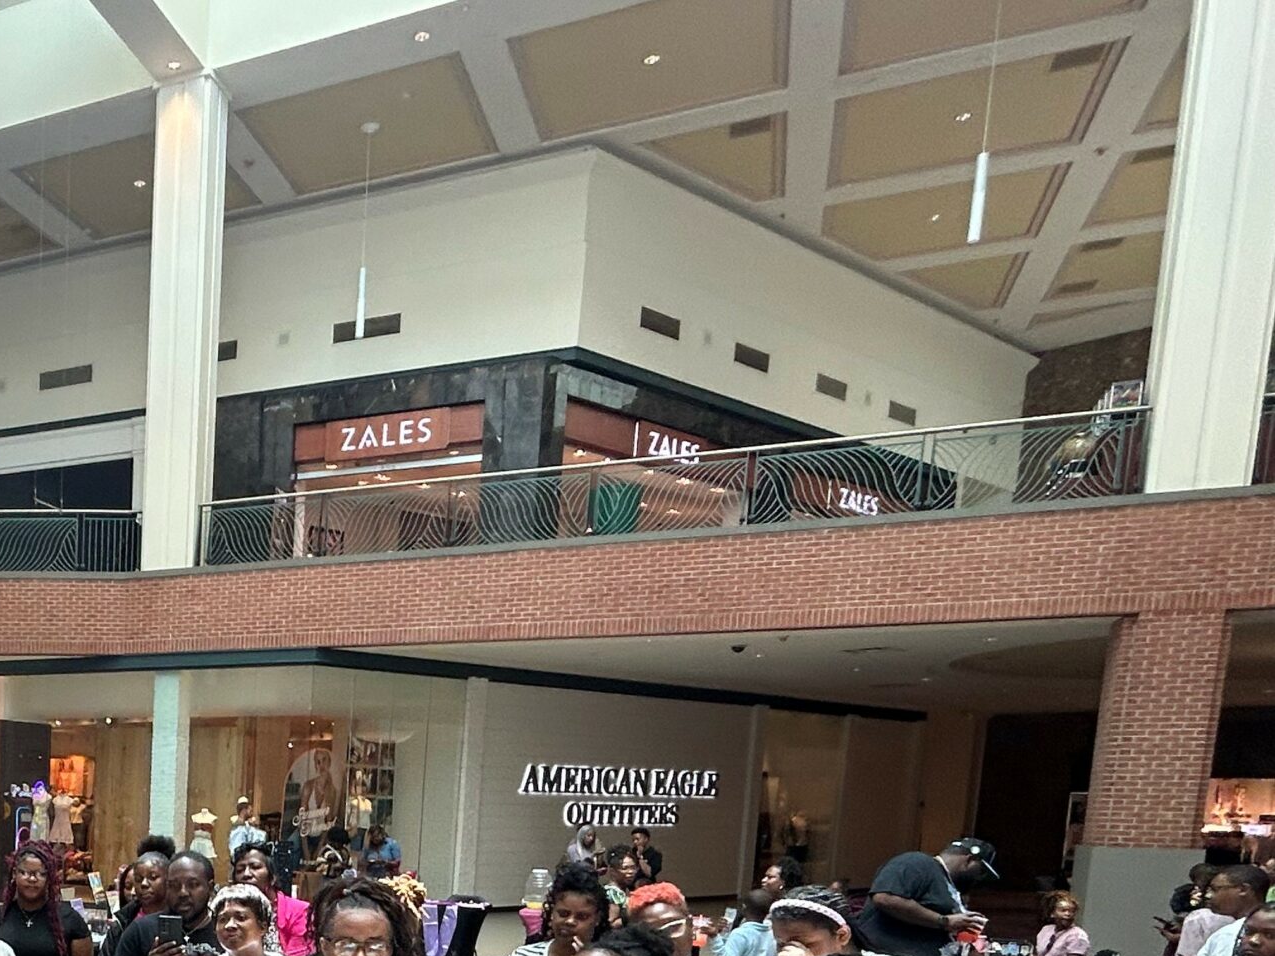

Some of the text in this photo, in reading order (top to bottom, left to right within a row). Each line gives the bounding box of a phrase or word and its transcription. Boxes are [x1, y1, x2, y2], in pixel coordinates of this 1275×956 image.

[341, 418, 432, 451] ZALES
[647, 431, 700, 464] ZALES
[839, 488, 878, 516] ZALES
[519, 764, 720, 798] AMERICAN EAGLE
[564, 801, 679, 826] OUTFITTERS
